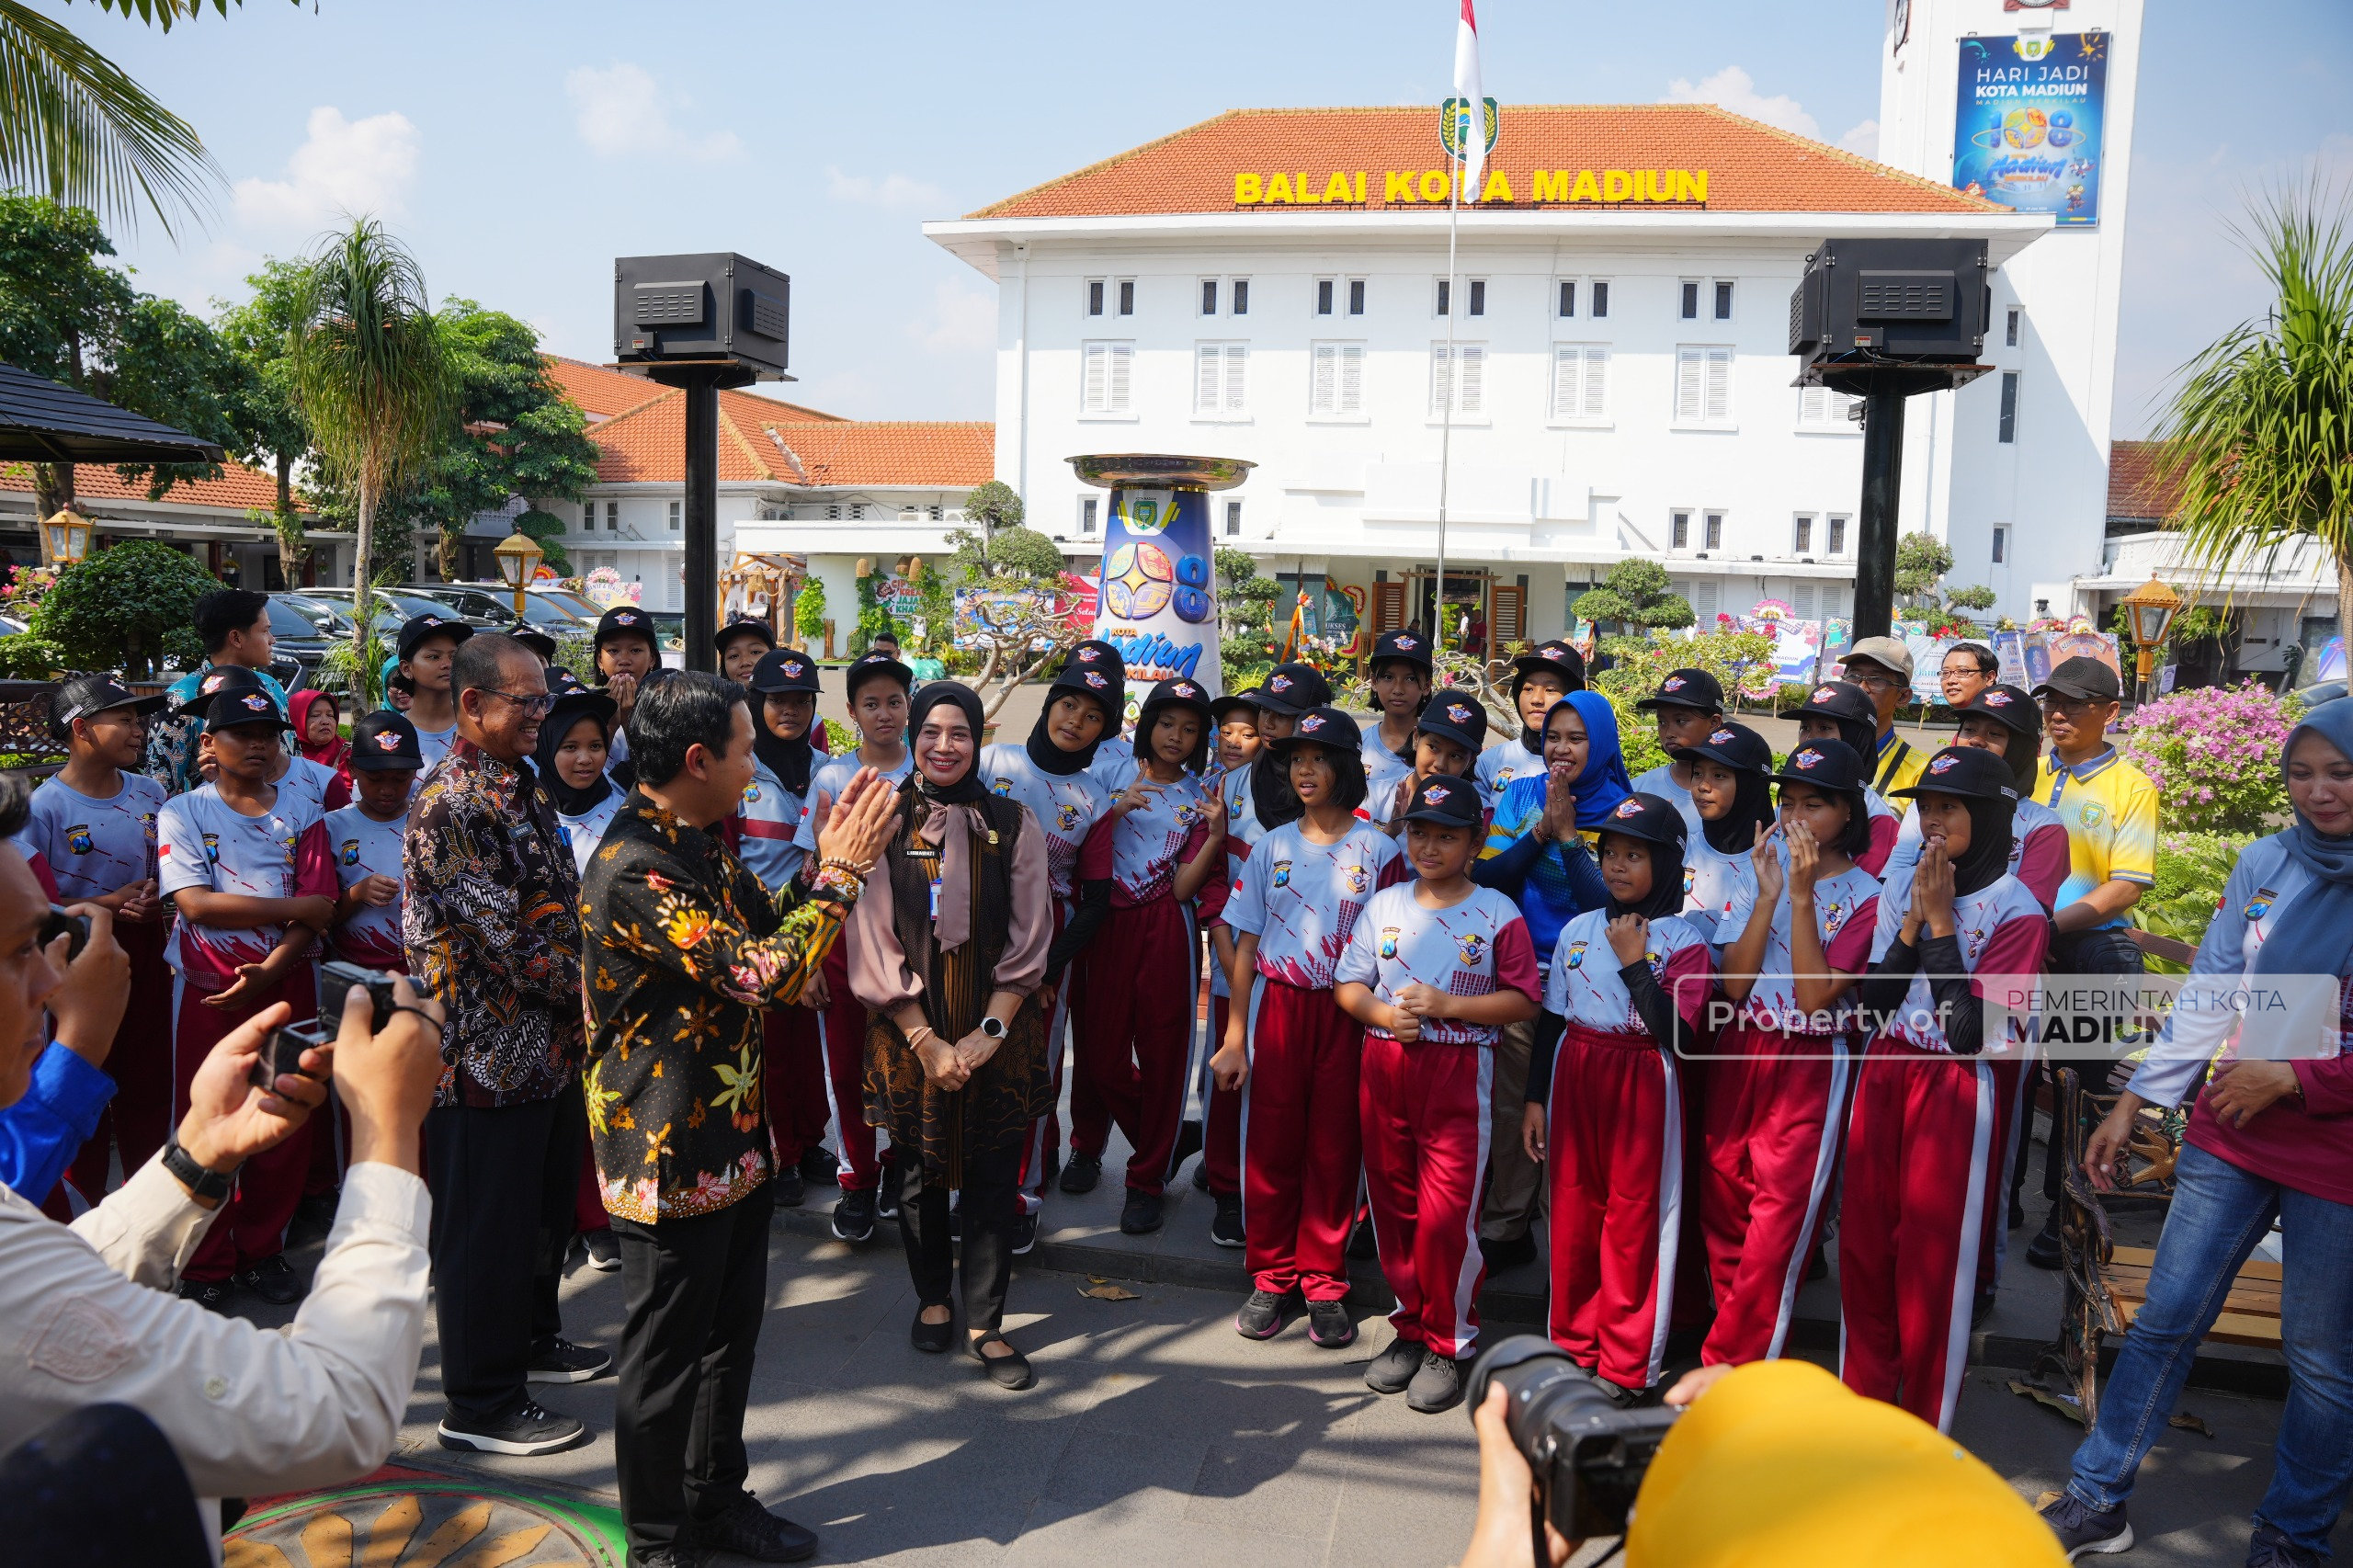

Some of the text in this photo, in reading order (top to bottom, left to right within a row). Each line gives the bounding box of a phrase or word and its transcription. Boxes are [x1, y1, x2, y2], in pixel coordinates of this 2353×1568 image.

[1977, 65, 2088, 83] HARI JADI
[1976, 83, 2088, 97] KOTA MADIUN
[1234, 172, 1367, 203] BALAI
[1533, 169, 1707, 202] MADIUN
[892, 579, 907, 587] CIP
[897, 597, 920, 605] JAJA
[896, 605, 917, 613] KHA
[1325, 622, 1347, 631] UKSES
[1776, 620, 1797, 634] SUKSES
[1126, 668, 1174, 681] KILAU
